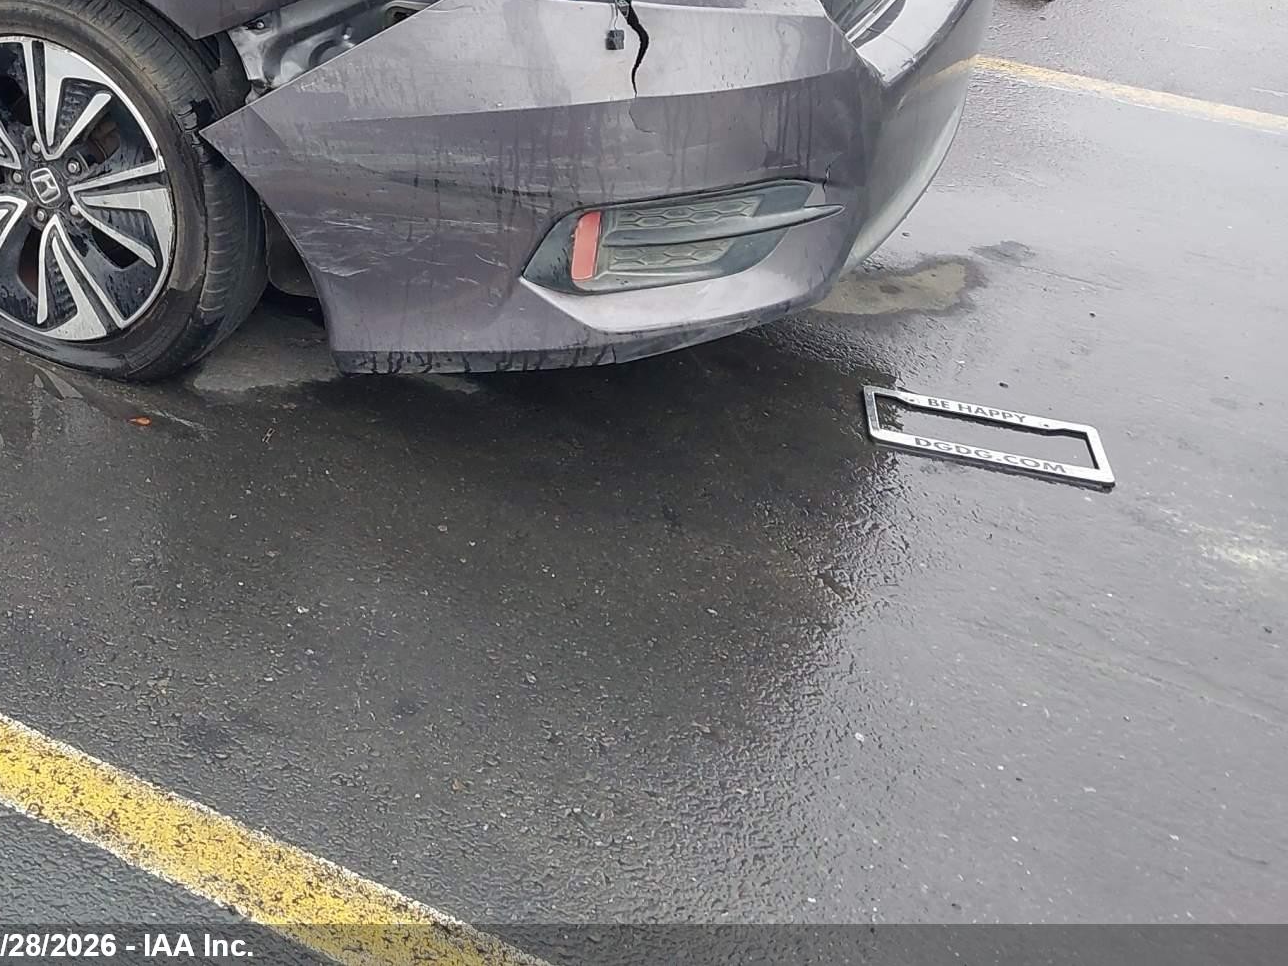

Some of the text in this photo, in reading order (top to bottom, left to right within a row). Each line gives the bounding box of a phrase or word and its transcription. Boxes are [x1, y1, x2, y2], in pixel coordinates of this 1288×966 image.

[927, 398, 1027, 423] BE HAPPY
[914, 437, 1067, 474] DGDG.COM
